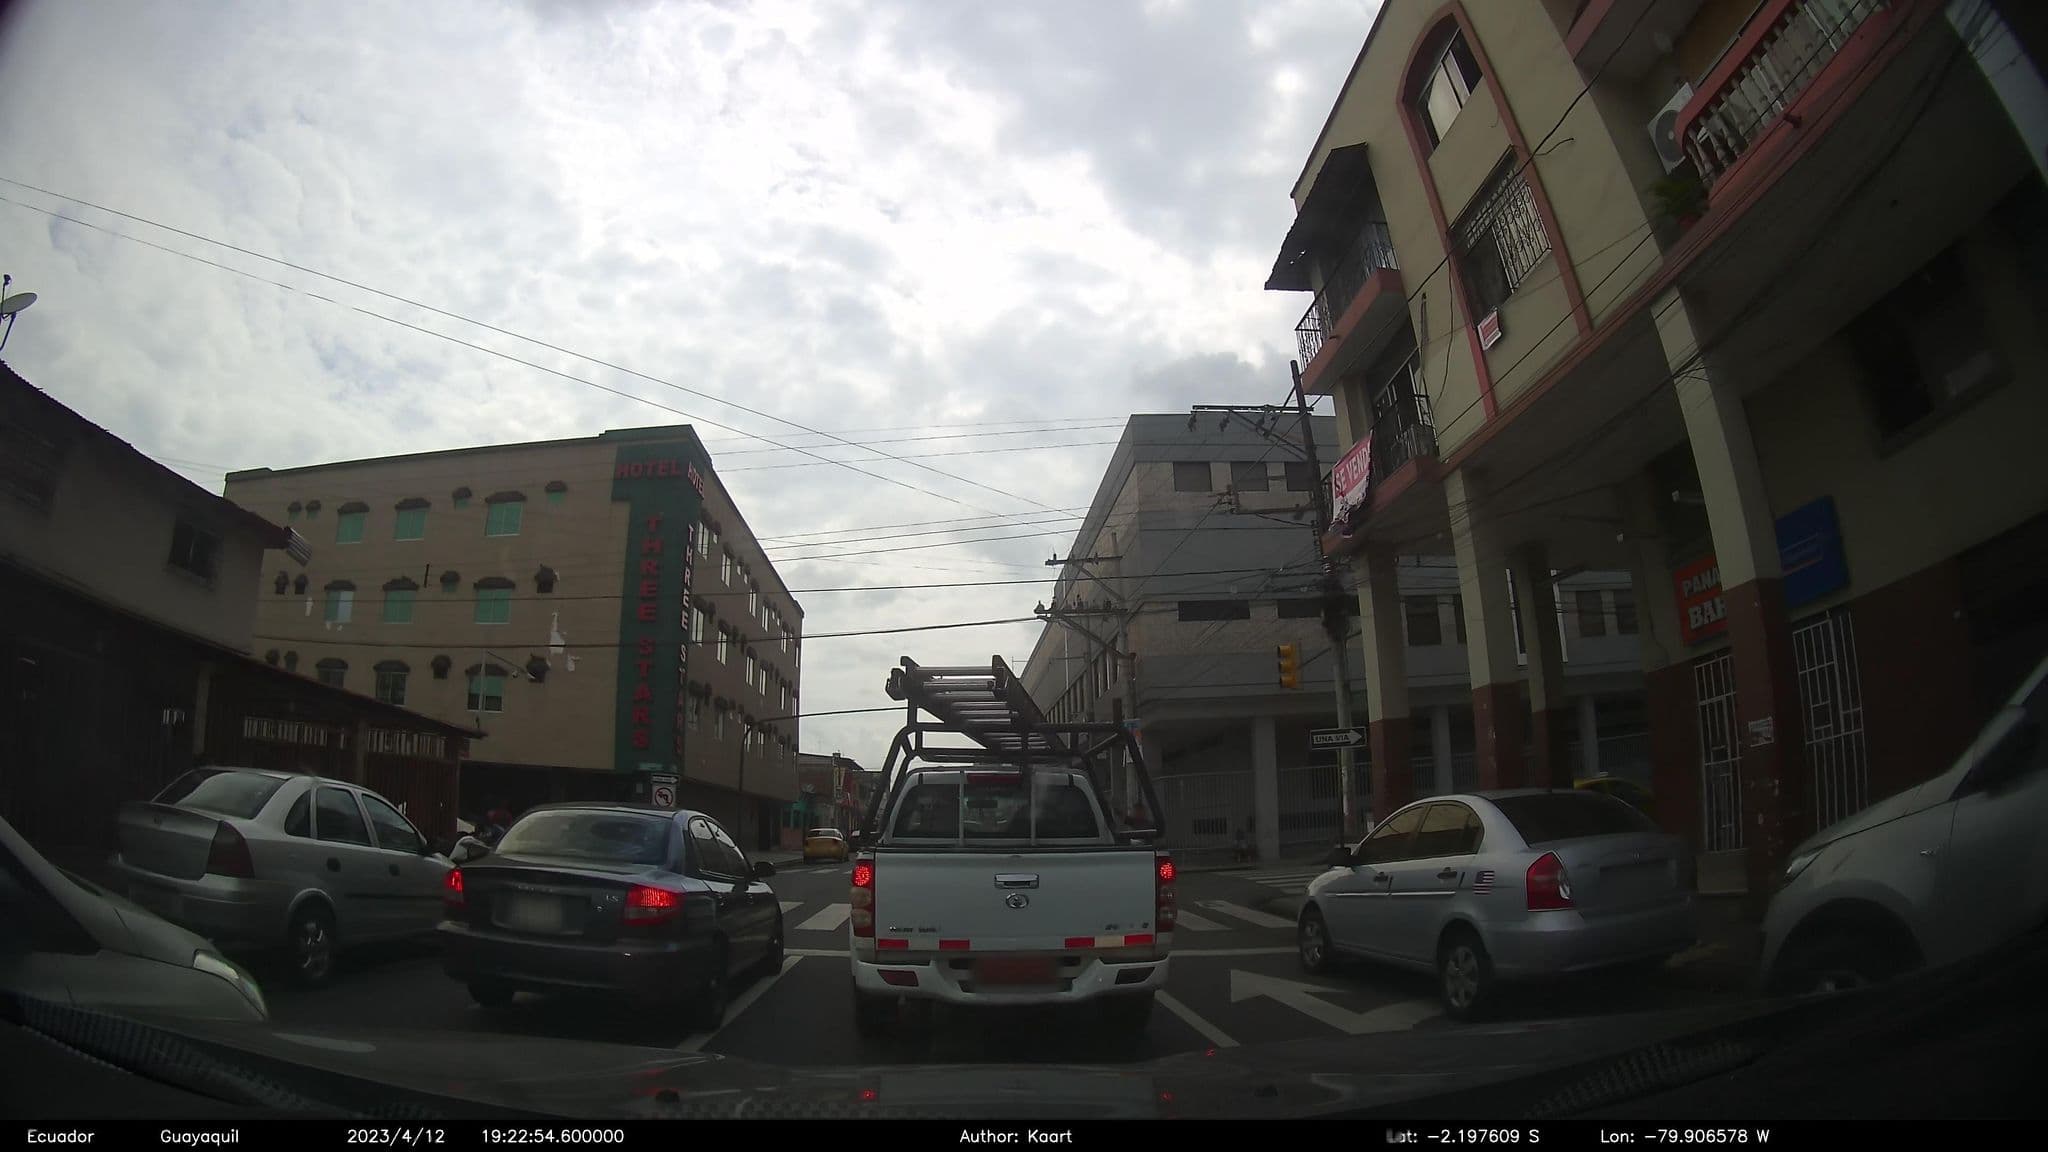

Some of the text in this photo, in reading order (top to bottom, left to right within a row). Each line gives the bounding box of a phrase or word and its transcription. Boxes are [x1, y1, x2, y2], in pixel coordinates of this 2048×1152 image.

[616, 459, 681, 480] HOTEL
[1335, 447, 1370, 491] SE VEND
[639, 513, 663, 621] THREE
[632, 637, 655, 749] STARS
[675, 524, 695, 755] THREE STARS
